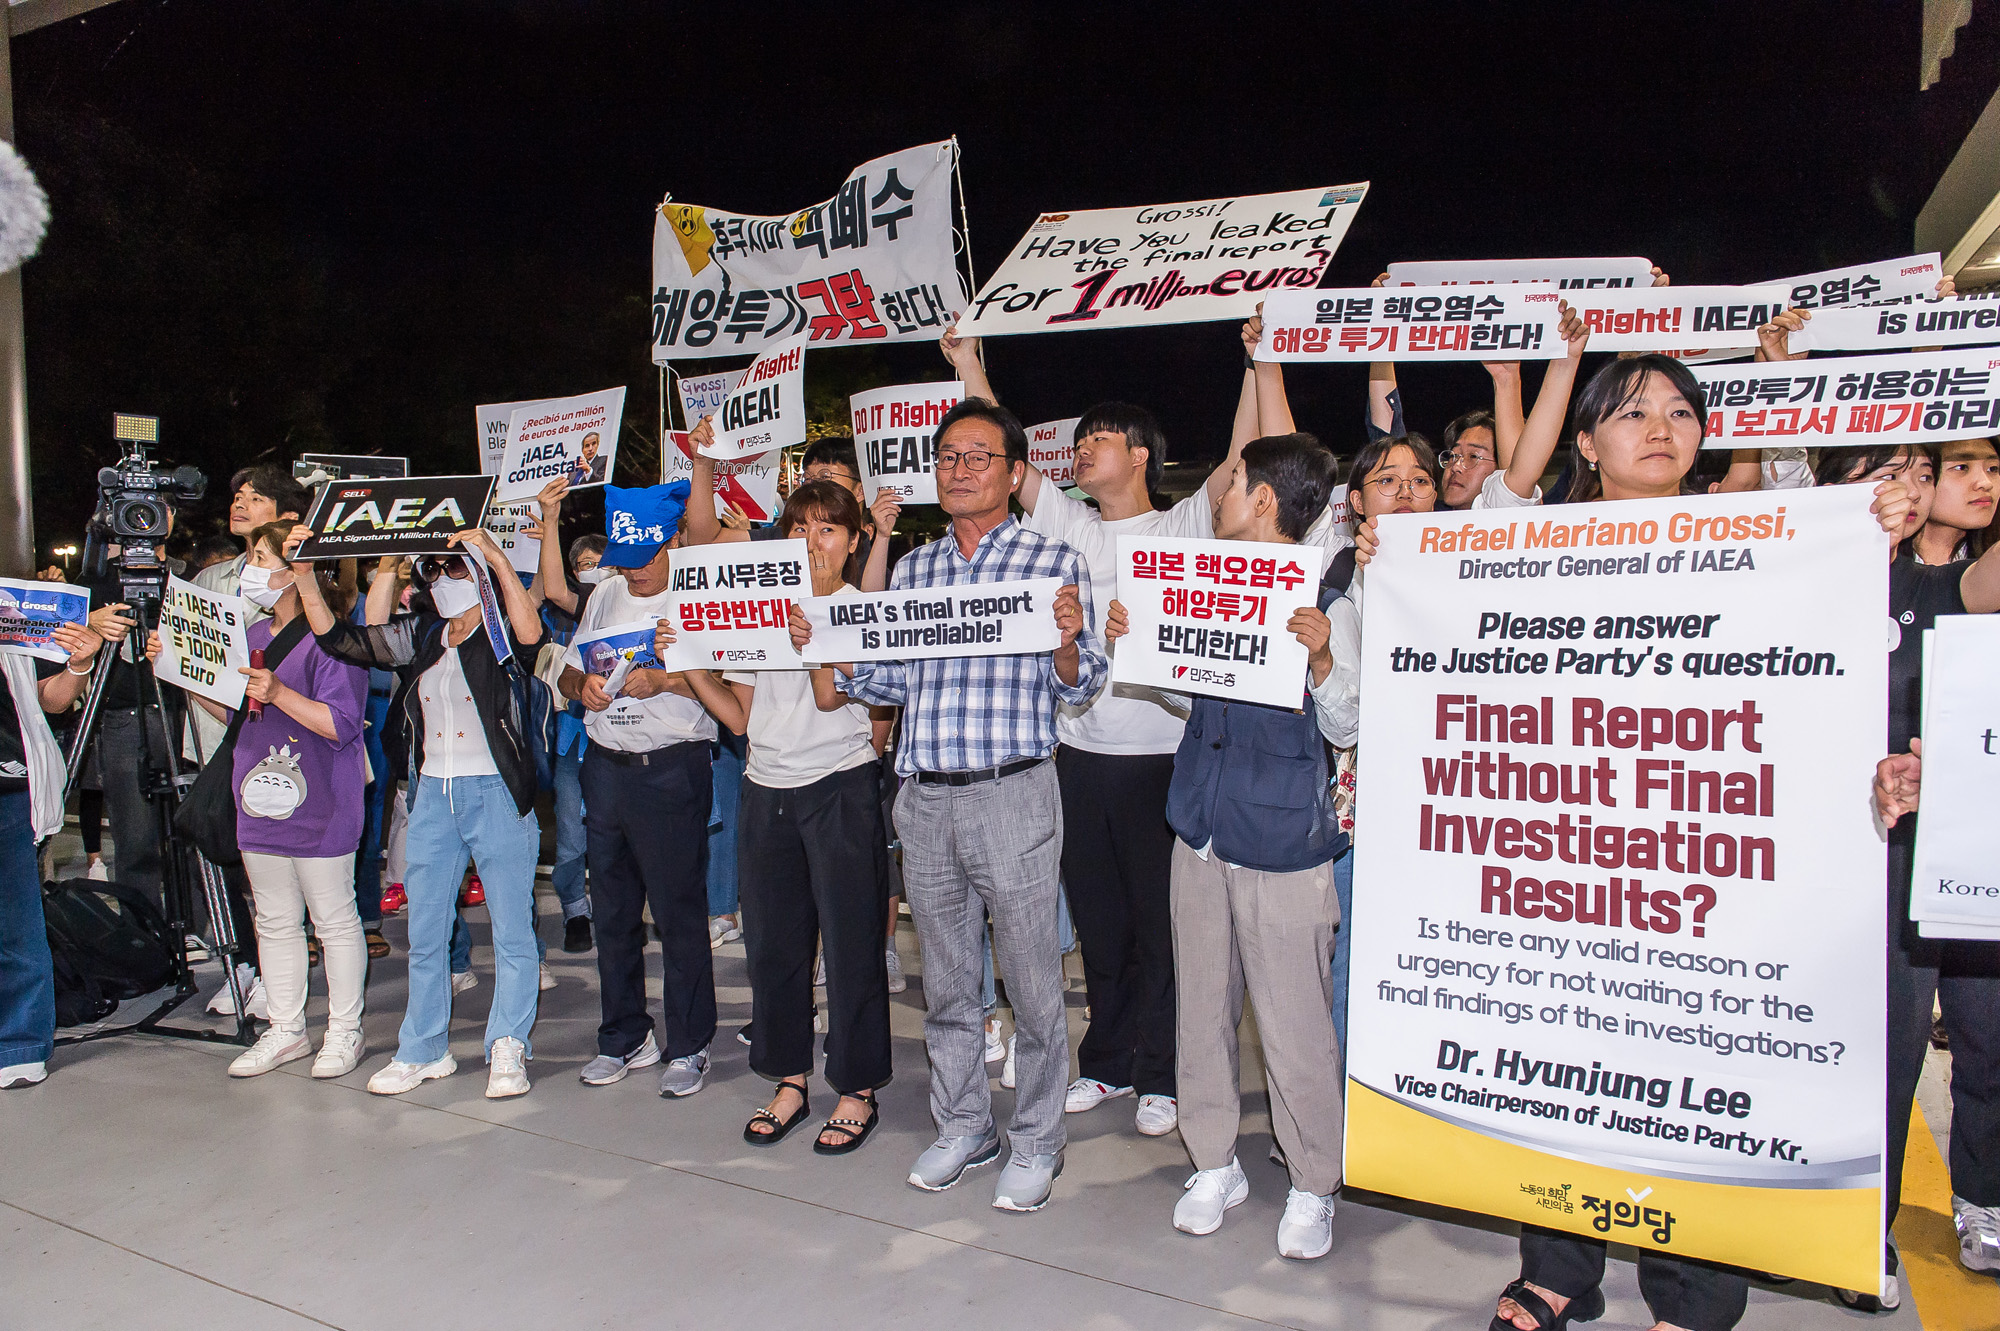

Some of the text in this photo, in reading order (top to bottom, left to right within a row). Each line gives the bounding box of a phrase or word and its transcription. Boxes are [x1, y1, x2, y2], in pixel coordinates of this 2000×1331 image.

[1136, 201, 1234, 224] Grossi!
[710, 215, 788, 261] 후쿠시마
[1021, 236, 1121, 259] Have
[1073, 235, 1332, 273] the final report
[973, 283, 1062, 321] for
[1046, 269, 1119, 324] 1
[1103, 270, 1211, 311] million
[1790, 274, 1881, 308] 오염수
[653, 285, 808, 347] 해양투기
[1315, 295, 1504, 324] 일본 핵오염수
[1583, 307, 1682, 334] Right!
[1877, 311, 1908, 335] is
[1272, 323, 1543, 353] 해양 투기 반대한다!
[753, 346, 801, 383] Right!
[681, 379, 726, 395] Grossi
[1835, 368, 1990, 402] 허용하는
[686, 394, 706, 409] Did
[722, 383, 780, 432] IAEA!
[519, 417, 606, 442] de euros de Japón?
[522, 405, 604, 430] ¿Recibió un millón
[855, 408, 867, 435] DO
[871, 404, 884, 430] IT
[1732, 406, 1838, 438] 보고서
[1846, 399, 2000, 434] 폐기하라
[746, 433, 771, 447] 민주노총
[1034, 427, 1056, 441] No!
[508, 456, 581, 483] contesta!
[520, 442, 568, 467] ¡IAEA,
[866, 436, 930, 477] IAEA!
[323, 498, 466, 533] IAEA
[509, 505, 531, 516] will
[344, 533, 391, 542] Signature
[502, 539, 515, 549] to
[1420, 506, 1797, 554] Rafael Mariano Grossi,
[672, 560, 801, 591] IAEA 사무총장
[1132, 550, 1305, 591] 일본 핵오염수
[1459, 548, 1755, 580] Director General of IAEA
[186, 593, 236, 626] IAEA's
[679, 598, 793, 632] 방한반대!
[830, 591, 1033, 627] IAEA's final report
[1162, 587, 1268, 626] 해양투기
[12, 634, 51, 643] euros?
[21, 618, 60, 628] leaked
[31, 627, 47, 635] for
[161, 605, 231, 647] Signature
[861, 620, 1002, 650] is unreliable!
[1478, 611, 1720, 640] Please answer
[174, 636, 227, 667] = 100M
[596, 649, 617, 661] Rafael
[726, 650, 767, 661] 민주노총
[1158, 624, 1268, 665] 반대한다!
[180, 656, 215, 686] Euro
[1190, 667, 1236, 687] 민주노총
[1390, 645, 1845, 678] the Justice Party's question.
[1436, 694, 1763, 753] Final Report
[1422, 751, 1774, 817] without Final
[1419, 804, 1775, 881] Investigation
[1481, 865, 1717, 938] Results?
[1417, 917, 1790, 982] Is there any valid reason or
[1398, 952, 1815, 1023] urgency for not waiting for the
[1377, 980, 1846, 1066] final findings of the investigations?
[1436, 1039, 1752, 1118] Dr. Hyunjung Lee
[1394, 1074, 1809, 1164] Vice Chairperson of Justice Party Kr.
[1520, 1183, 1568, 1201] 노동의 희망
[1536, 1197, 1574, 1214] 시민의 꿈
[1581, 1195, 1676, 1244] 정의당
